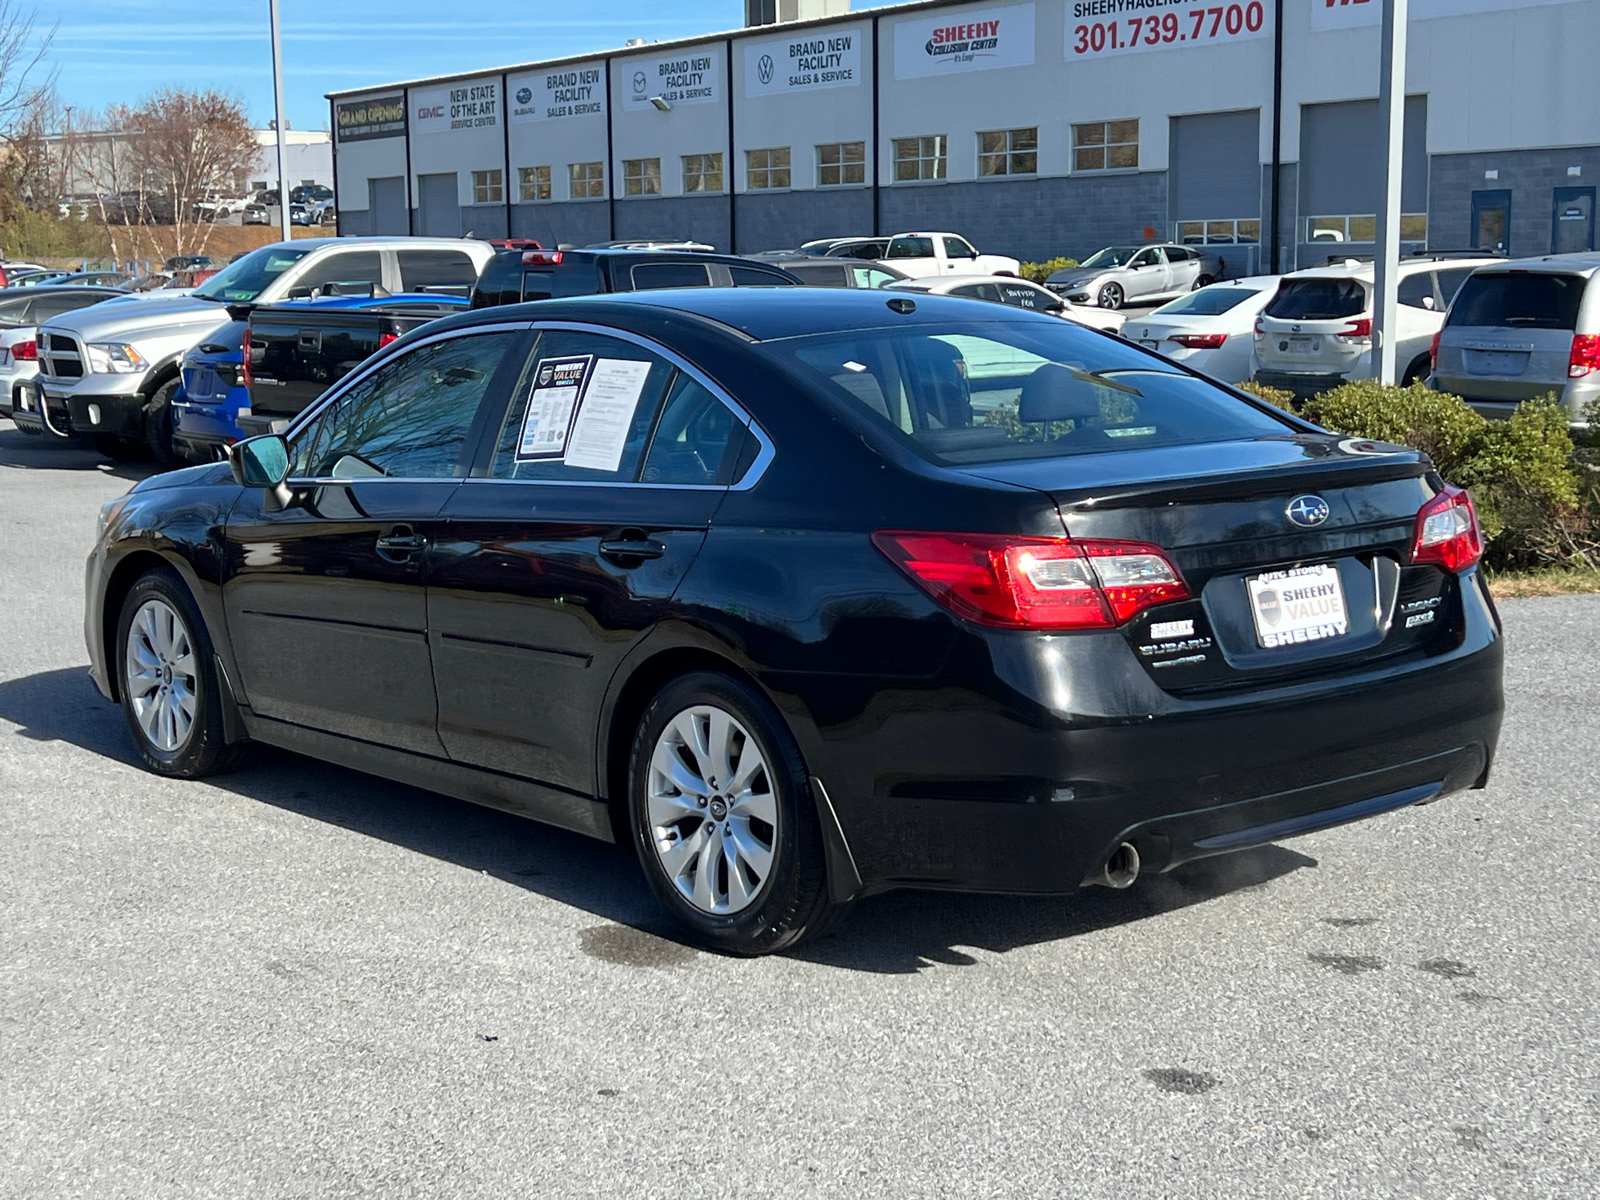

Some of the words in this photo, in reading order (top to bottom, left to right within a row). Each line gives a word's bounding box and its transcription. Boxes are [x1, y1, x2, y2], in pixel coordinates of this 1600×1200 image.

[933, 20, 1000, 44] SHEEHY
[1073, 1, 1264, 54] 301.739.7700
[789, 41, 825, 57] BRAND
[828, 37, 852, 53] NEW
[933, 42, 970, 55] COLLISION
[970, 38, 998, 51] CENTER
[659, 61, 688, 76] BRAND
[691, 57, 711, 71] NEW
[798, 54, 842, 72] FACILITY
[546, 73, 577, 89] BRAND
[579, 69, 600, 84] NEW
[666, 72, 703, 88] FACILITY
[789, 74, 812, 86] SALES
[813, 73, 819, 83] &
[821, 69, 853, 82] SERVICE
[450, 89, 469, 103] NEW
[470, 85, 495, 100] STATE
[554, 86, 592, 103] FACILITY
[679, 90, 685, 99] &
[686, 87, 712, 98] SERVICE
[340, 109, 367, 126] GRAND
[368, 103, 403, 122] OPENING
[418, 106, 445, 119] GMC
[450, 105, 461, 118] OF
[462, 103, 477, 117] THE
[479, 101, 496, 115] ART
[547, 106, 567, 118] SALES
[567, 105, 573, 116] &
[574, 102, 601, 115] SERVICE
[451, 119, 473, 130] SERVICE
[474, 116, 497, 128] CENTER
[554, 370, 582, 380] VALUE
[1282, 583, 1335, 602] SHEEHY
[1286, 597, 1340, 620] VALUE
[1263, 620, 1348, 648] SHEEHY
[1138, 636, 1212, 656] SUBARU
